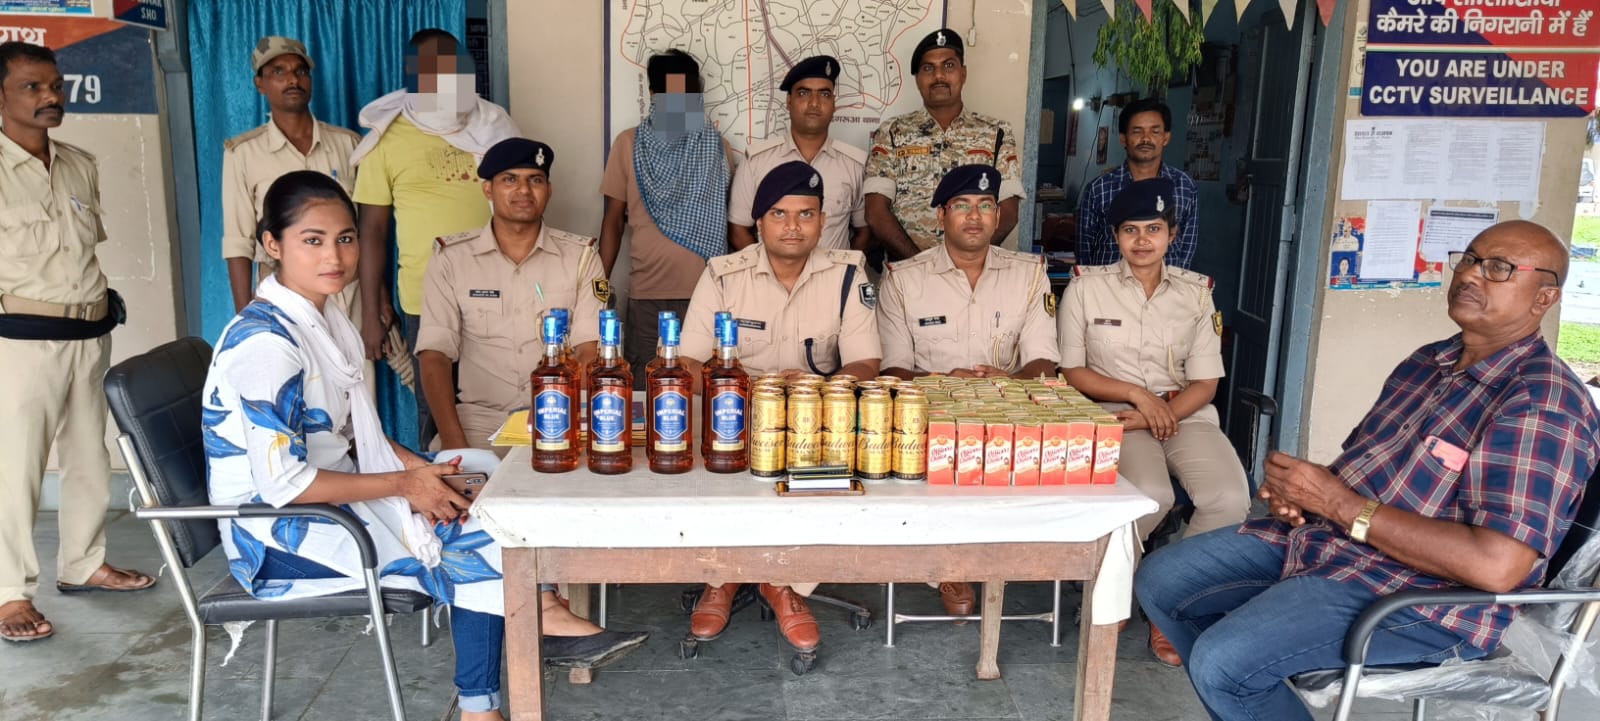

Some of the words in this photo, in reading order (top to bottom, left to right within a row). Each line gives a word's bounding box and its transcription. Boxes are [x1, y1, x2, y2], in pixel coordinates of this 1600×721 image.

[1376, 7, 1427, 33] कैमरे
[1430, 8, 1459, 34] की
[1463, 8, 1544, 35] निगरानी
[1549, 10, 1571, 35] में
[1572, 9, 1594, 37] हैं
[1396, 58, 1439, 78] YOU
[1444, 60, 1487, 78] ARE
[1492, 60, 1565, 79] UNDER
[1369, 85, 1424, 105] CCTV
[1429, 86, 1589, 106] SURVEILLANCE
